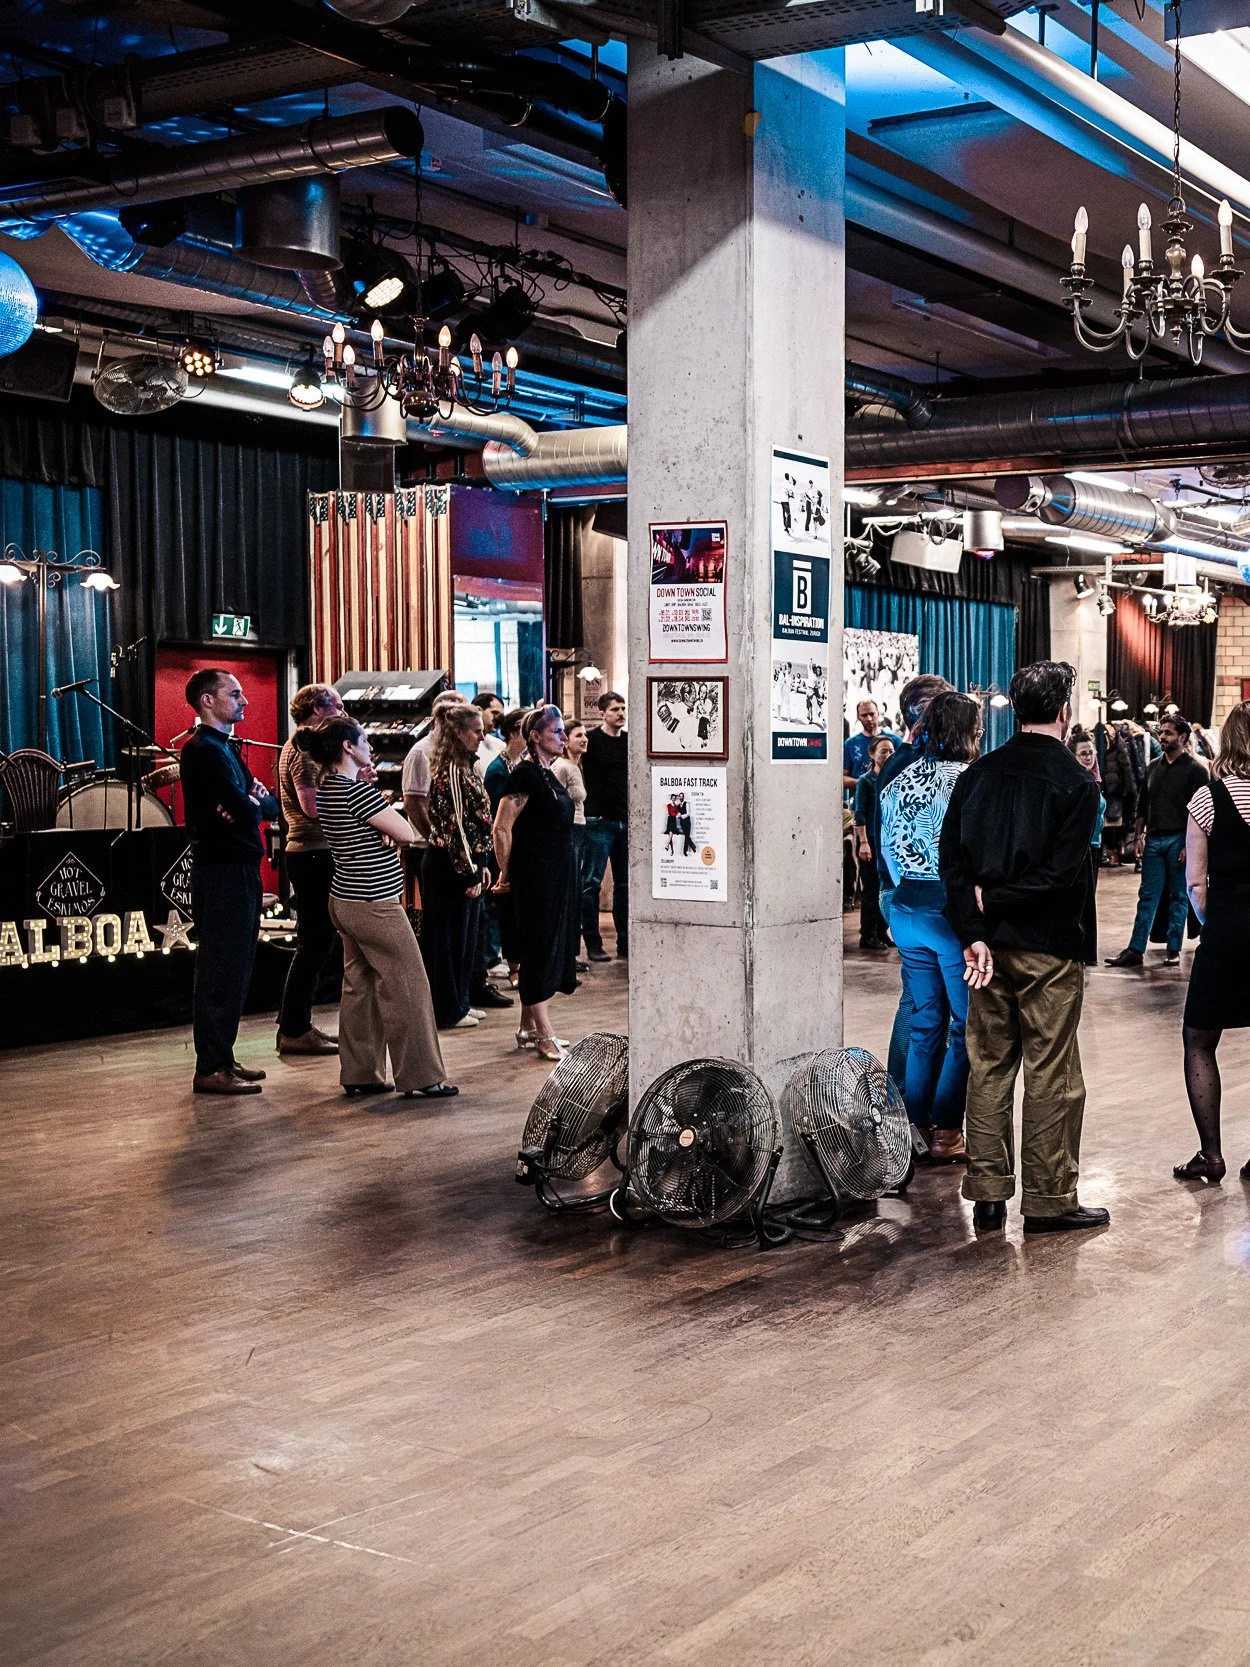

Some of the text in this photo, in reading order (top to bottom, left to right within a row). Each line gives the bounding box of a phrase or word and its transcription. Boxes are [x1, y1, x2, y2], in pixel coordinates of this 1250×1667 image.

[656, 587, 716, 598] DOWN TOWN SOCIAL
[797, 575, 808, 609] B
[662, 624, 710, 632] DOWNTOWNSWING
[778, 614, 824, 629] BAL-INSPIRATION
[660, 778, 718, 787] BALBOA FAST TRACK
[59, 866, 82, 880] HOT
[50, 880, 92, 898] GRAVEL
[47, 896, 96, 916] ESKIMOS
